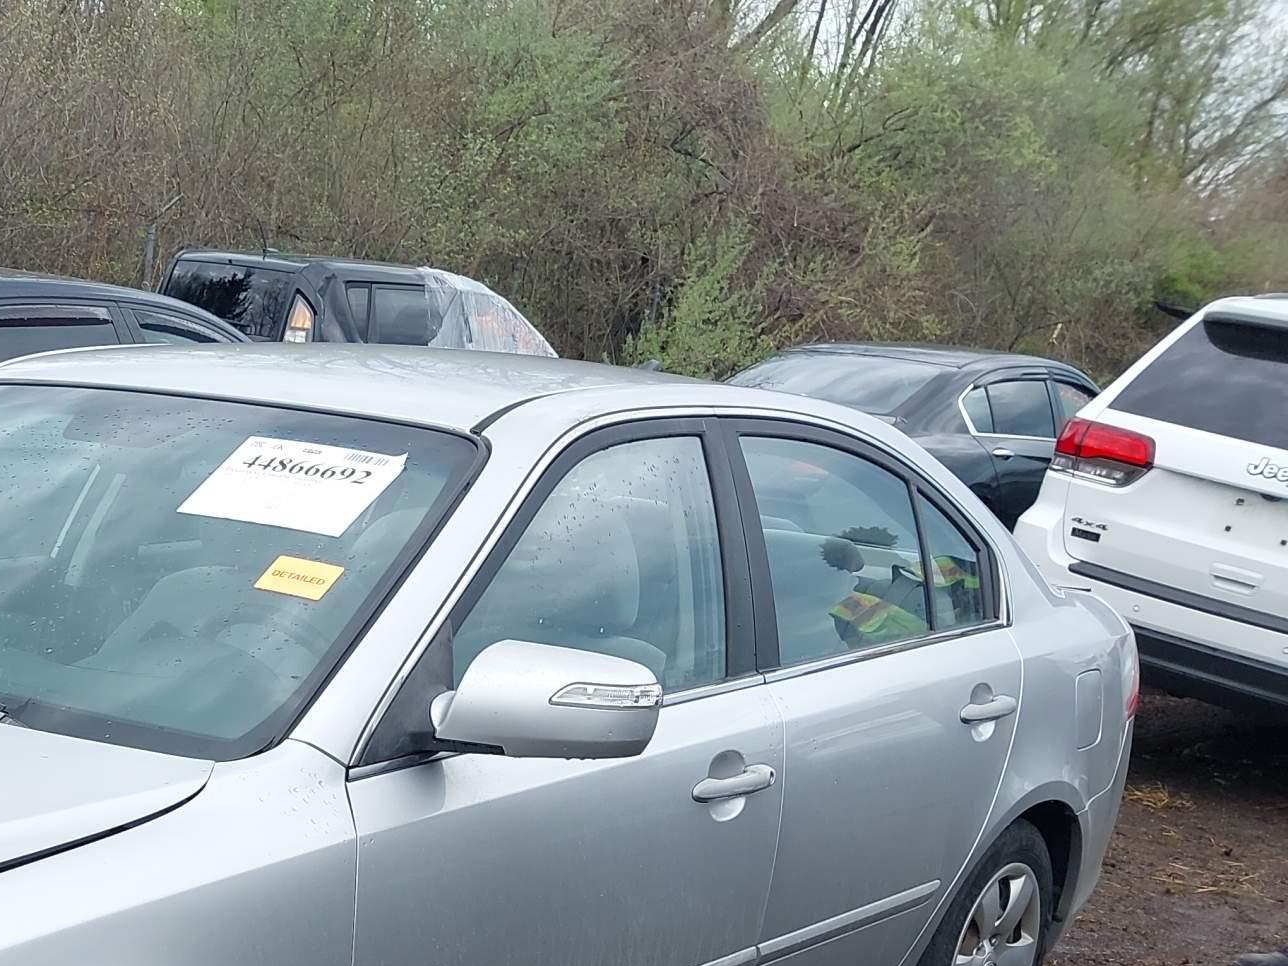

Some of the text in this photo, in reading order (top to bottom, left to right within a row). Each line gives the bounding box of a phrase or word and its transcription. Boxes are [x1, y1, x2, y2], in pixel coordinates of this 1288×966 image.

[241, 454, 373, 484] 44866692
[1247, 456, 1288, 482] Jee
[271, 568, 326, 586] DETAILED
